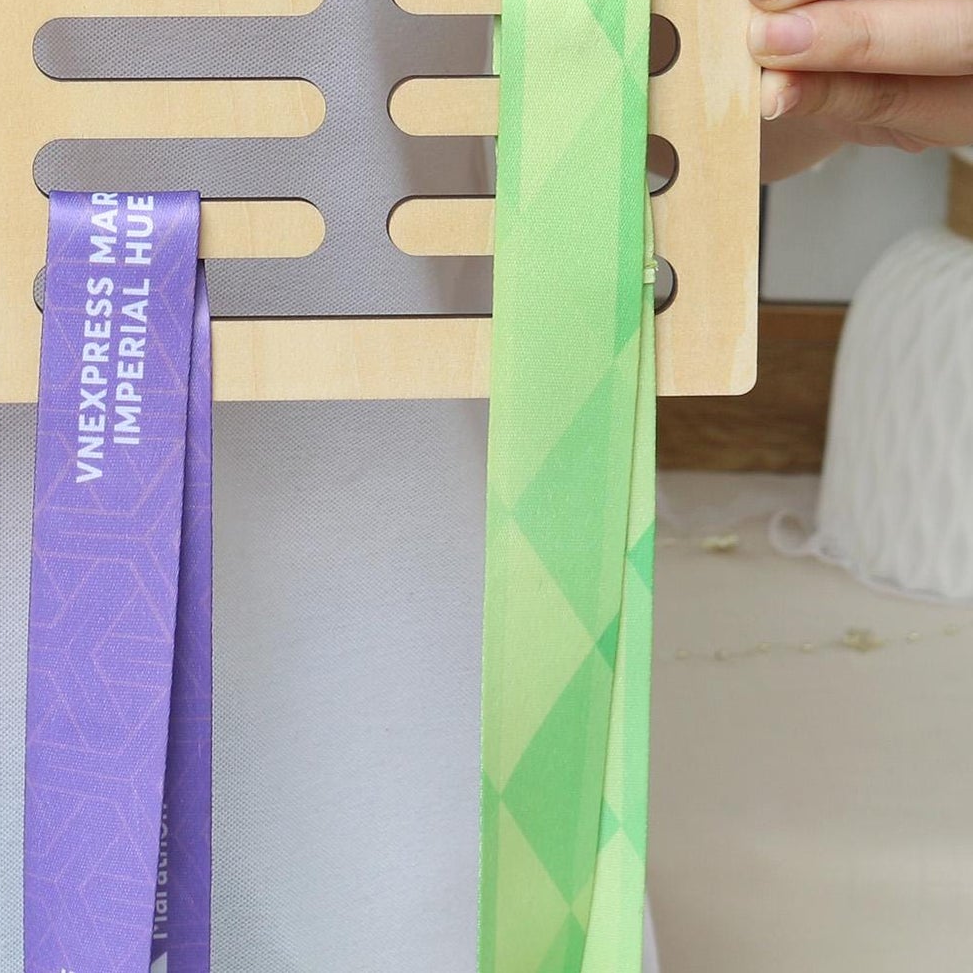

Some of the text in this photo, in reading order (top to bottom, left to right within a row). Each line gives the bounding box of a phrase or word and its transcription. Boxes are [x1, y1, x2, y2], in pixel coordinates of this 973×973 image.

[76, 277, 115, 484] VNEXPRESS
[113, 195, 154, 445] IMPERIAL HUE
